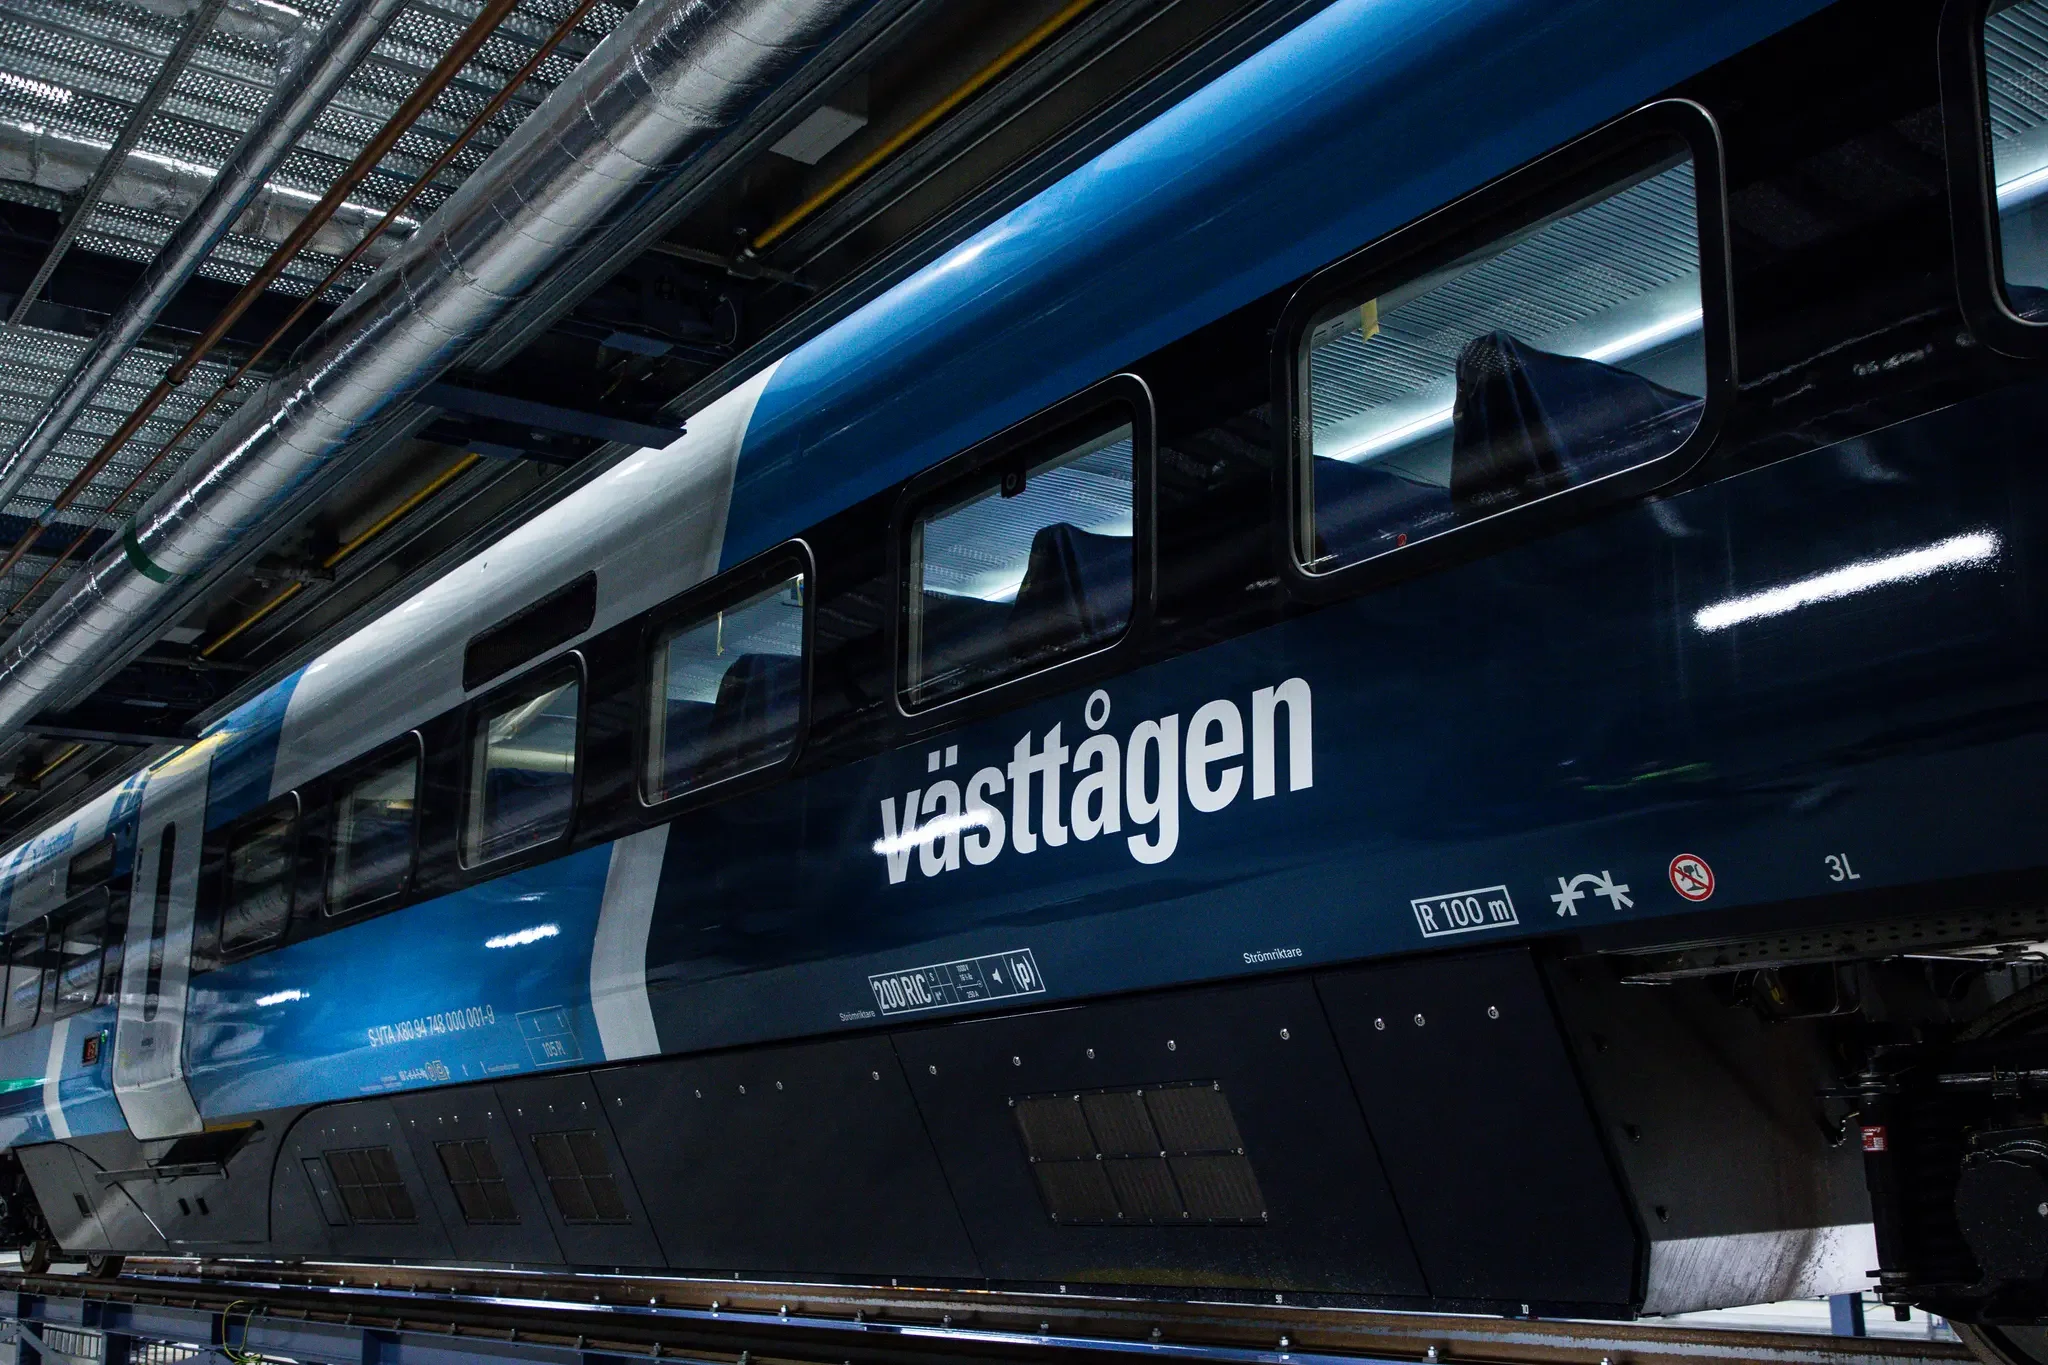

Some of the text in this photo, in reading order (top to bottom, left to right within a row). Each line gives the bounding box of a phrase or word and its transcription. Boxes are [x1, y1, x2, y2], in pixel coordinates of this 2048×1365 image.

[879, 677, 1313, 885] västtågen
[1824, 852, 1861, 882] 3L
[1419, 896, 1511, 931] R 100 m
[1243, 947, 1303, 964] Strömriktare
[873, 973, 932, 1010] 200 RIC
[367, 1023, 395, 1047] S-VTA
[426, 1014, 446, 1036] 748
[445, 1010, 466, 1032] 000
[466, 1004, 495, 1028] 001-9
[839, 1010, 876, 1022] Strömriktare
